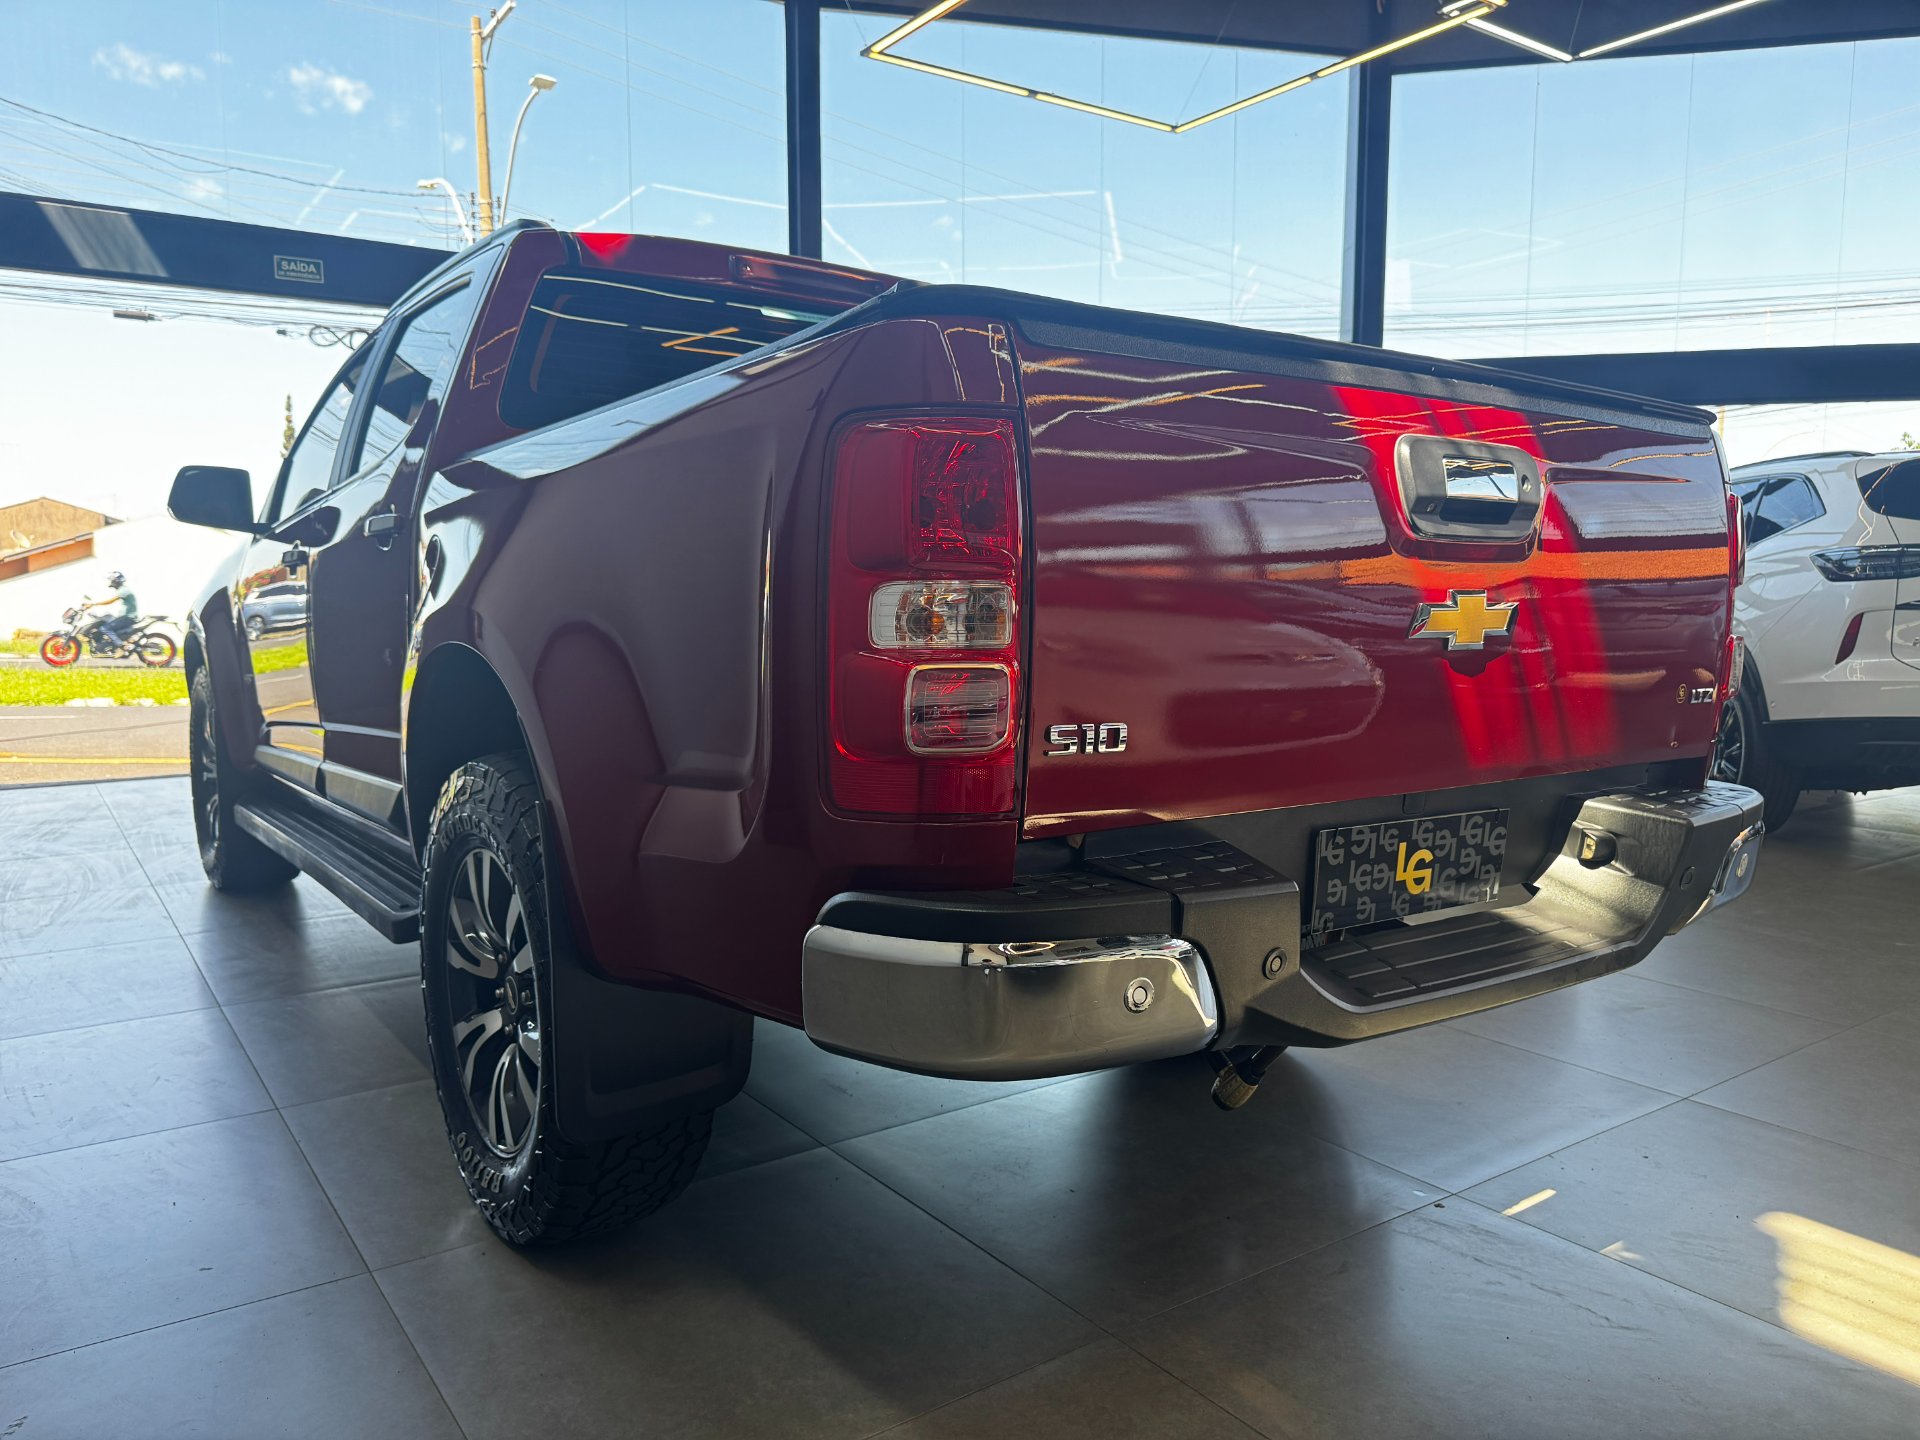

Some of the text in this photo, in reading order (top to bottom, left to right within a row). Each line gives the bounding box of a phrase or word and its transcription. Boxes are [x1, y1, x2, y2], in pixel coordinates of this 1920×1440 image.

[1690, 687, 1714, 704] LTZ
[1046, 722, 1128, 756] S10
[1380, 824, 1399, 852] LG
[1412, 821, 1434, 848] LG
[1460, 815, 1483, 845] LG
[1483, 822, 1507, 855] LG
[1321, 831, 1344, 865] LG
[1349, 860, 1372, 891] LG
[1396, 842, 1433, 895] LG
